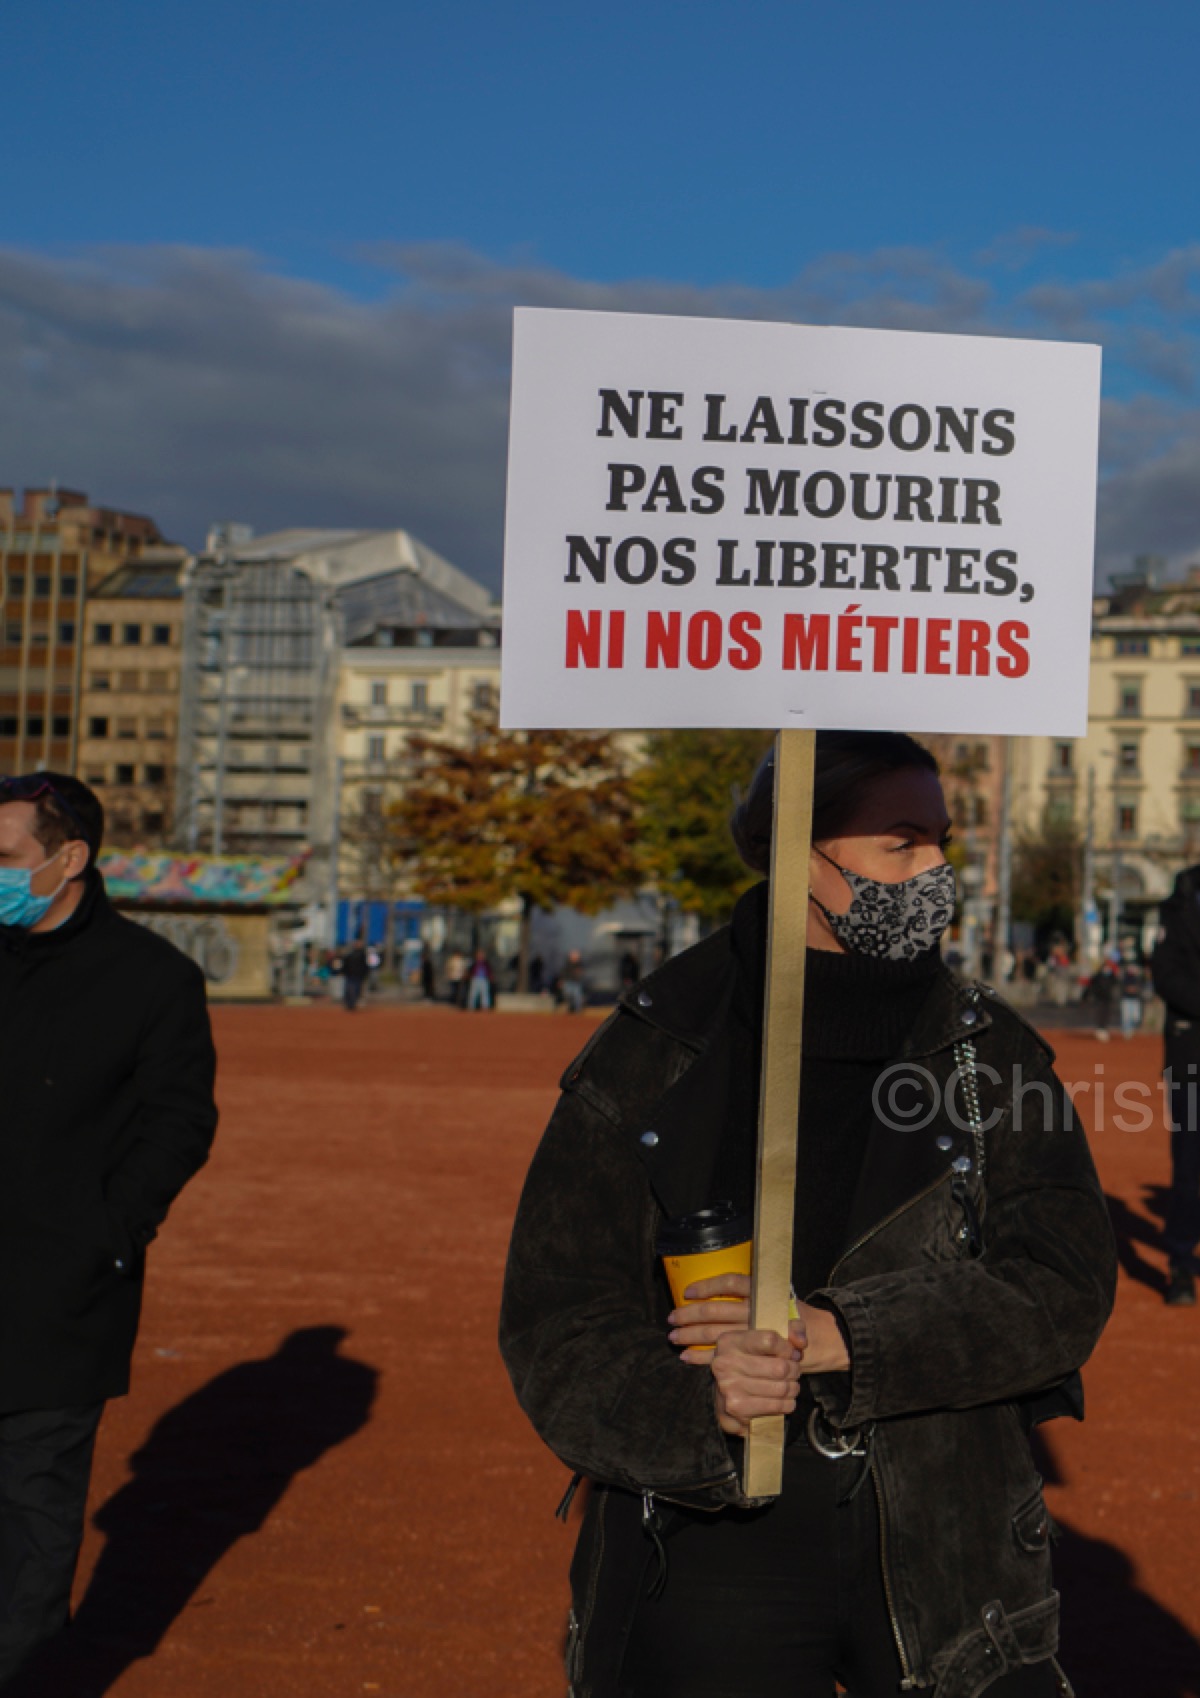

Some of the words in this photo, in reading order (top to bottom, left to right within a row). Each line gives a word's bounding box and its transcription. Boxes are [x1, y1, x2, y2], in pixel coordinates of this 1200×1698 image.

[596, 388, 685, 441] NE
[702, 393, 1015, 457] LAISSONS
[605, 463, 725, 515] PAS
[743, 467, 1002, 526] MOURIR
[563, 535, 697, 587] NOS
[715, 539, 1035, 603] LIBERTES,
[565, 609, 625, 670] NI
[645, 610, 763, 671] NOS
[781, 603, 1031, 679] MÉTIERS
